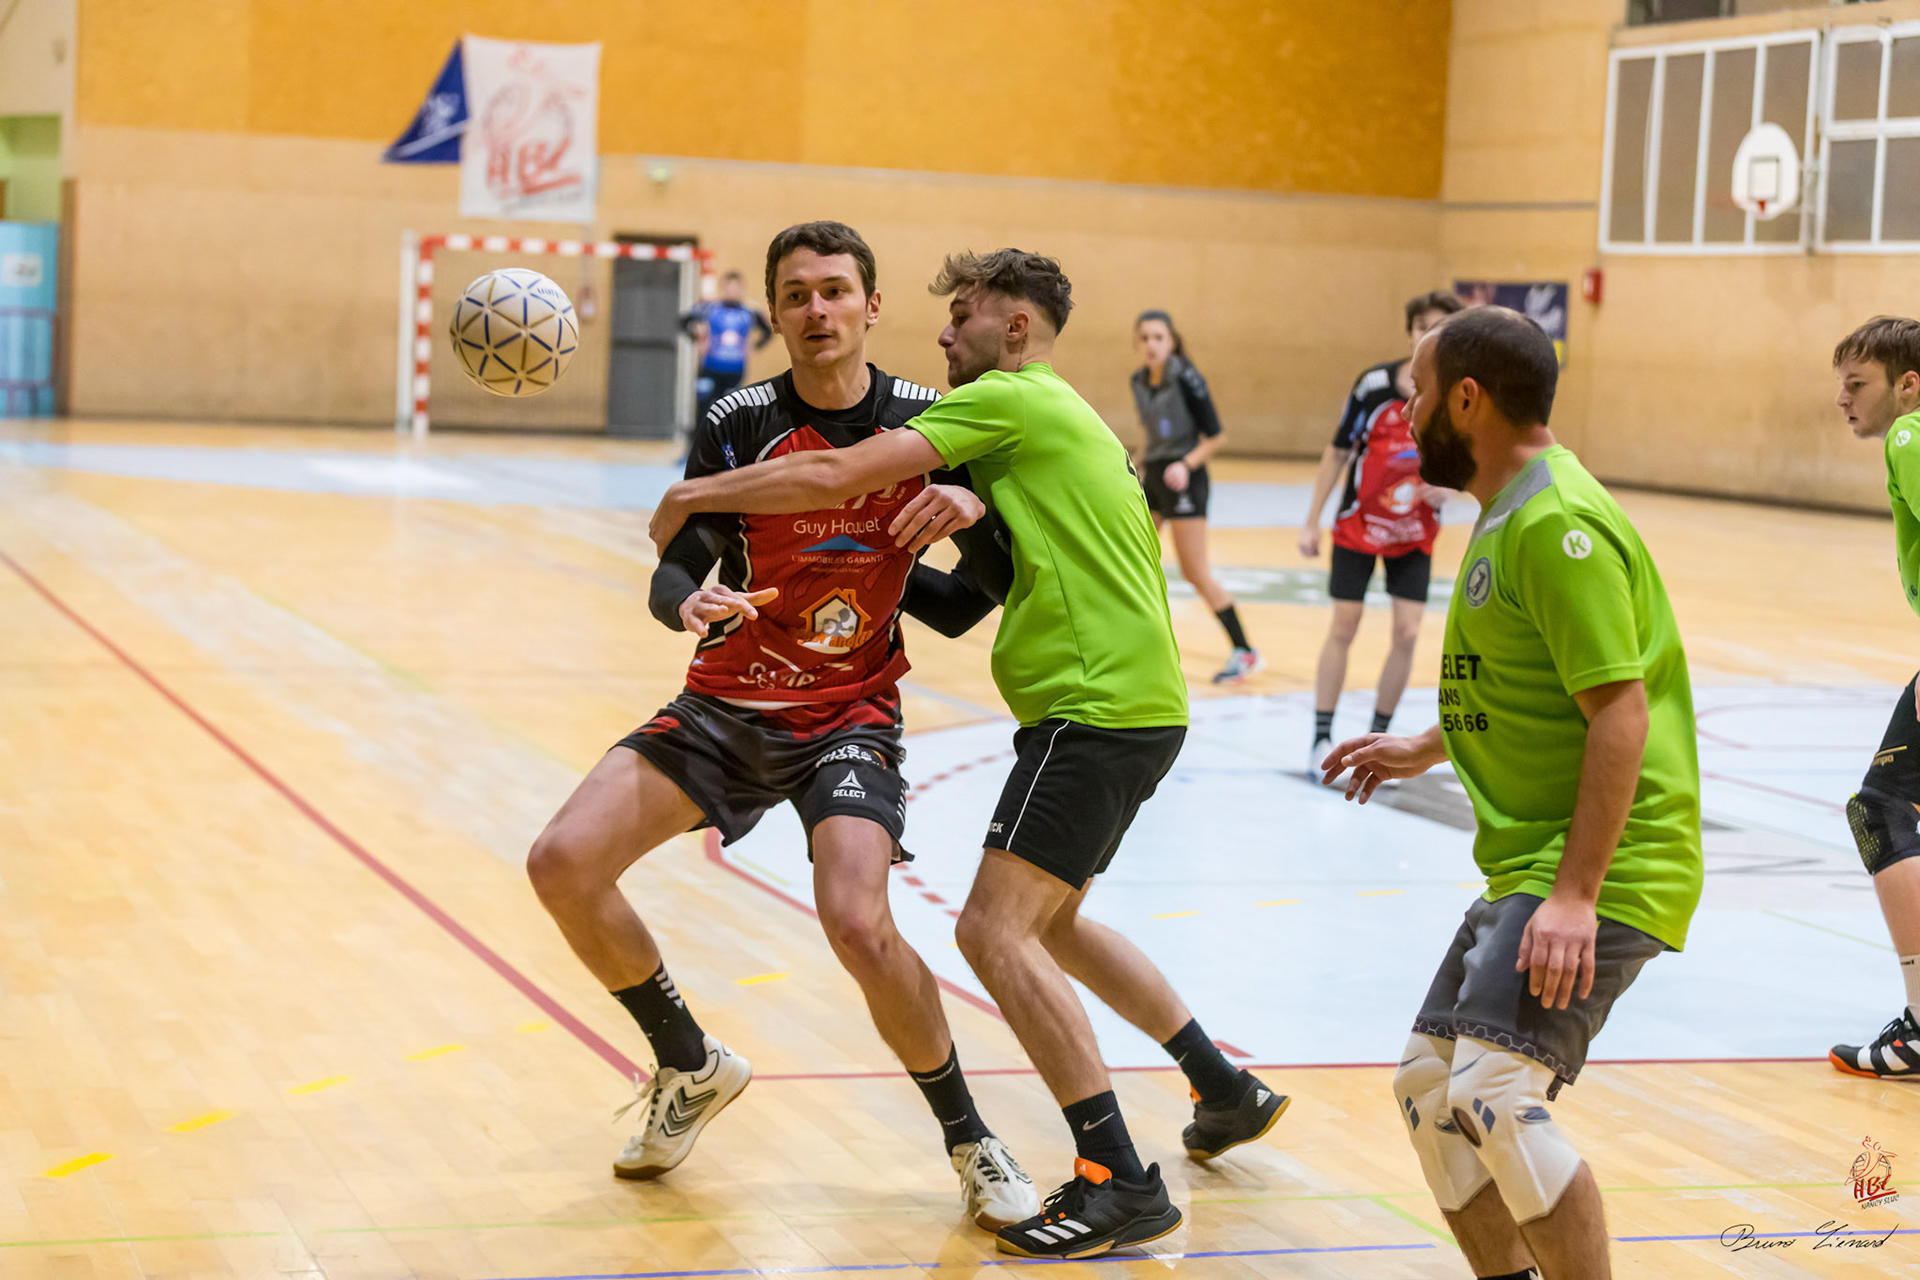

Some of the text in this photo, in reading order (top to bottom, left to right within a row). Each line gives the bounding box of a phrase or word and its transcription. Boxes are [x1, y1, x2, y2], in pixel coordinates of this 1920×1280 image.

[793, 516, 881, 538] Guy Hoquet
[846, 553, 883, 564] GARANTI
[832, 789, 866, 799] SELECT
